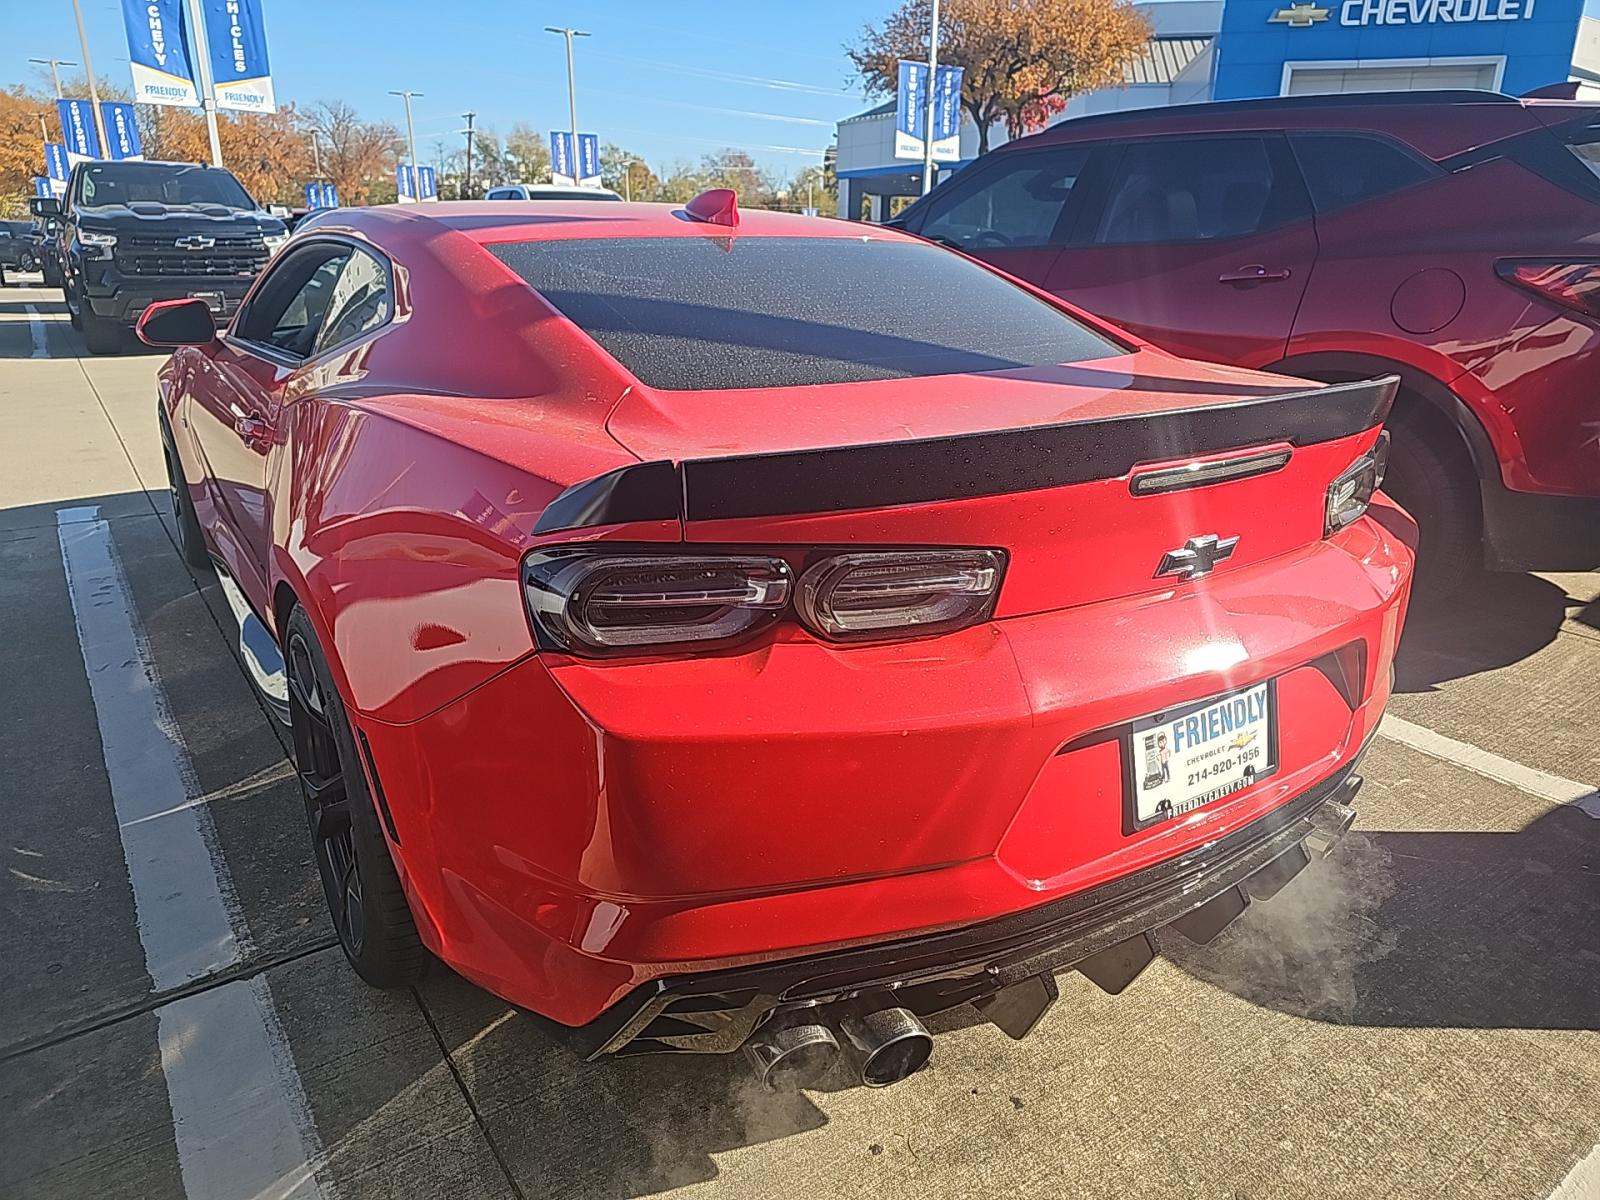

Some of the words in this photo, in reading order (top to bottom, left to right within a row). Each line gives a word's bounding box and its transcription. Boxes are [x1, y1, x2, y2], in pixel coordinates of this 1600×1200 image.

[147, 4, 167, 66] CHEVY
[1340, 0, 1535, 26] CHEVROLET
[226, 0, 247, 73] HICLES
[144, 84, 188, 98] FRIENDLY
[224, 91, 265, 105] FRIENDLY
[70, 101, 88, 155] CUSTOMER
[114, 107, 130, 154] PARKING
[1172, 689, 1267, 753] FRIENDLY
[1186, 745, 1226, 767] CHEVROLET
[1187, 746, 1260, 787] 214-920-1956
